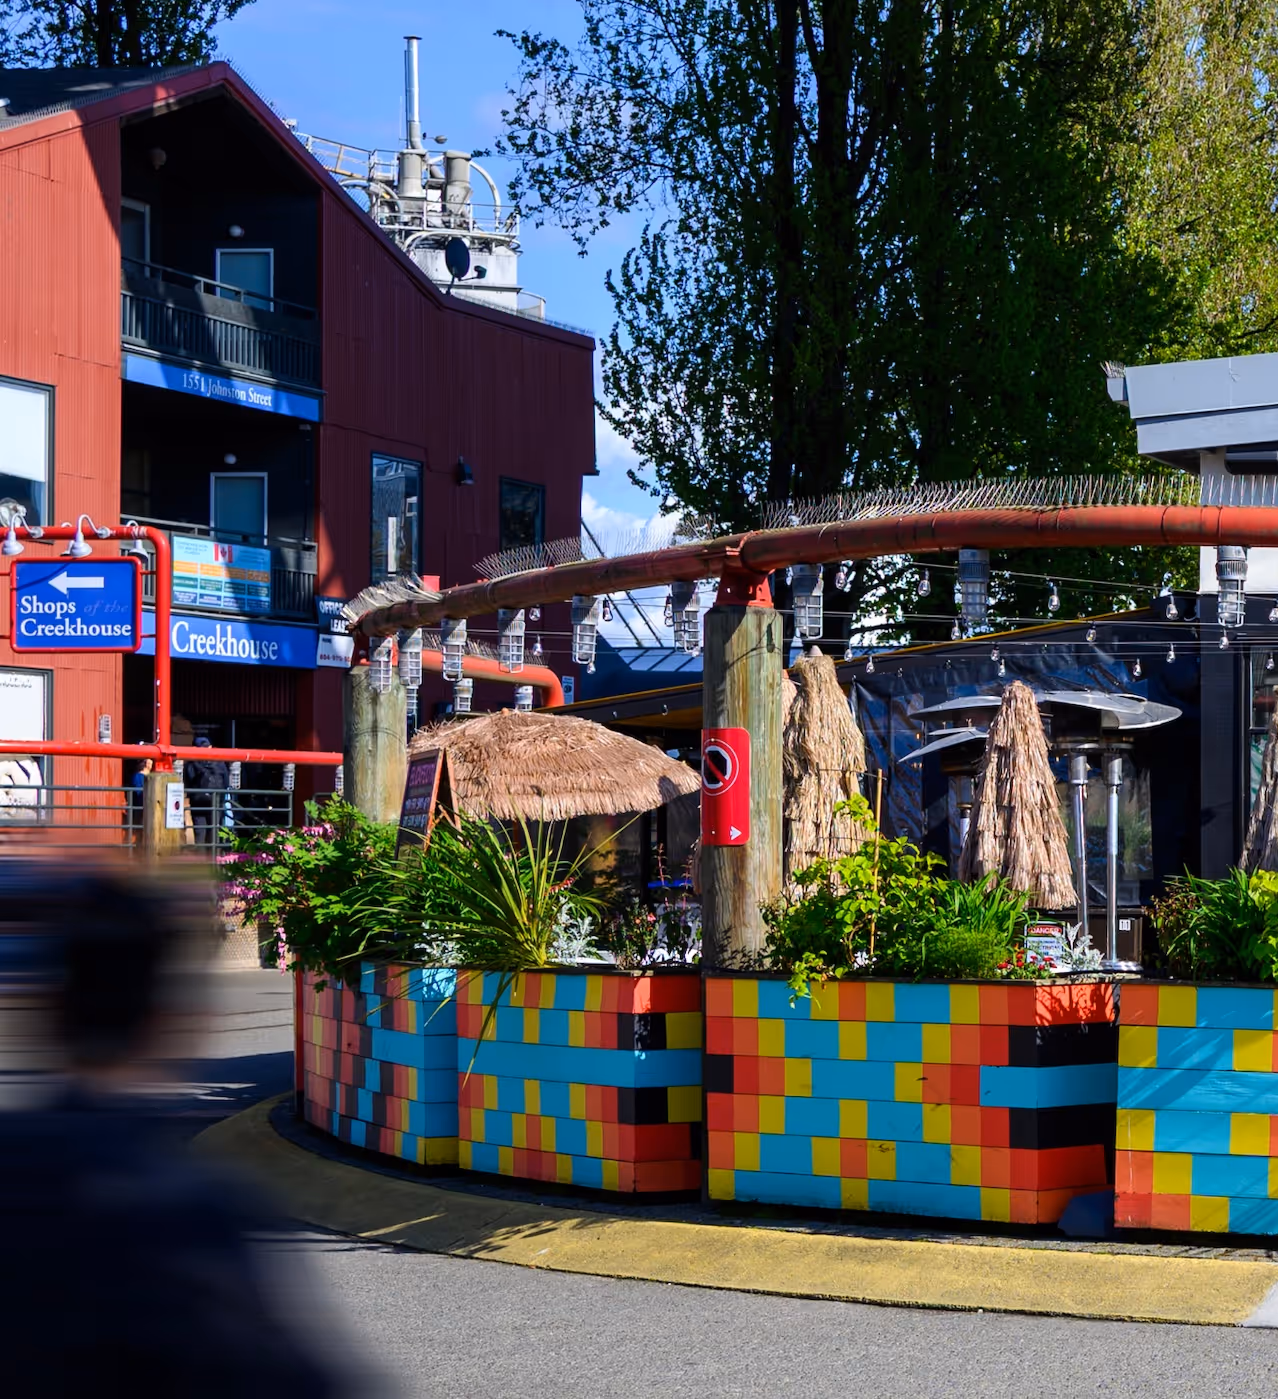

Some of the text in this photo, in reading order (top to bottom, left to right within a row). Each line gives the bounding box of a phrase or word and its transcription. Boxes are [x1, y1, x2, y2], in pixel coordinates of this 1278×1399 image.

[183, 372, 272, 406] 1551 Johnston Street
[20, 595, 76, 619] Shops
[20, 618, 132, 637] Creekhouse
[172, 621, 278, 660] Creekhouse
